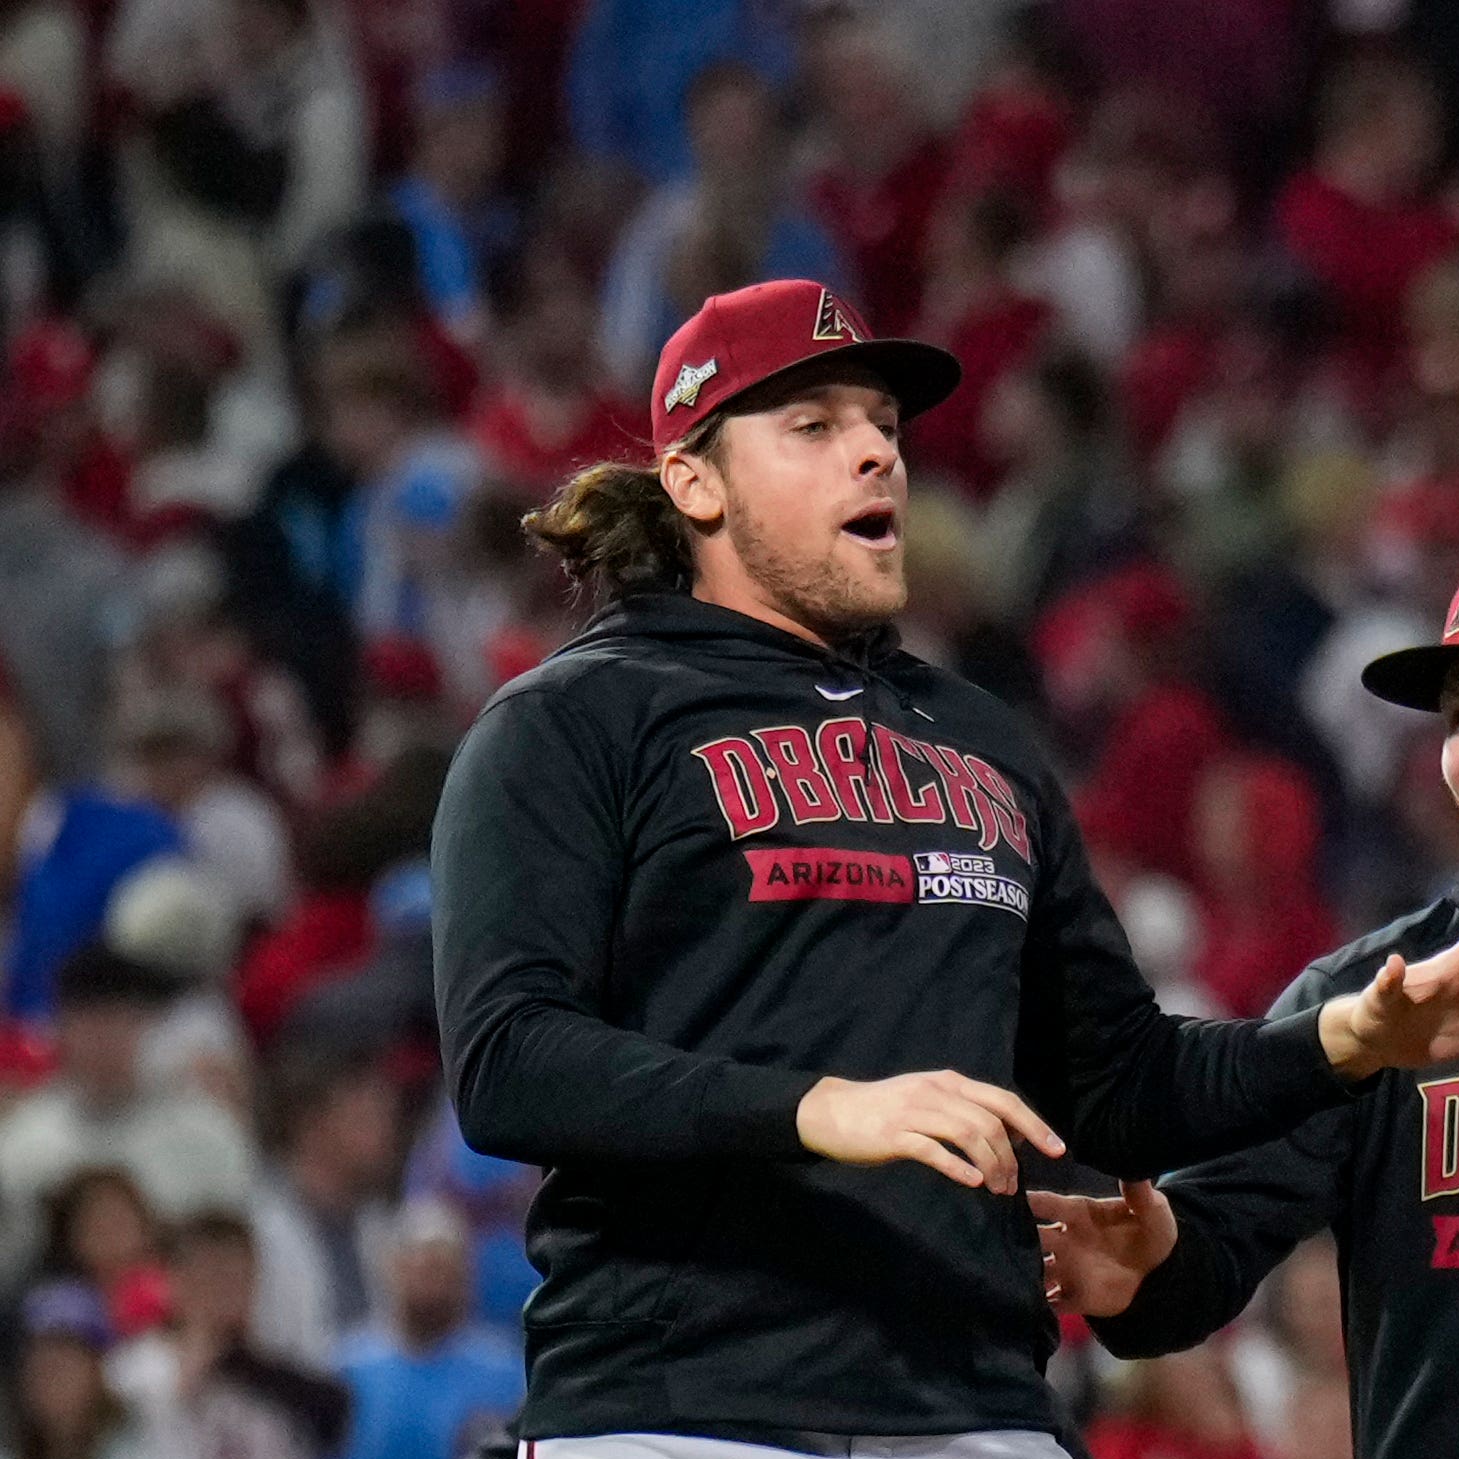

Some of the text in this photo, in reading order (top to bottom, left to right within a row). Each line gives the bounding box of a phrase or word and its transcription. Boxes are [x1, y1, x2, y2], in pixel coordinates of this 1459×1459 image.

[767, 861, 905, 888] ARIZONA
[951, 858, 995, 874] 2023
[918, 875, 1030, 916] POSTSEASON
